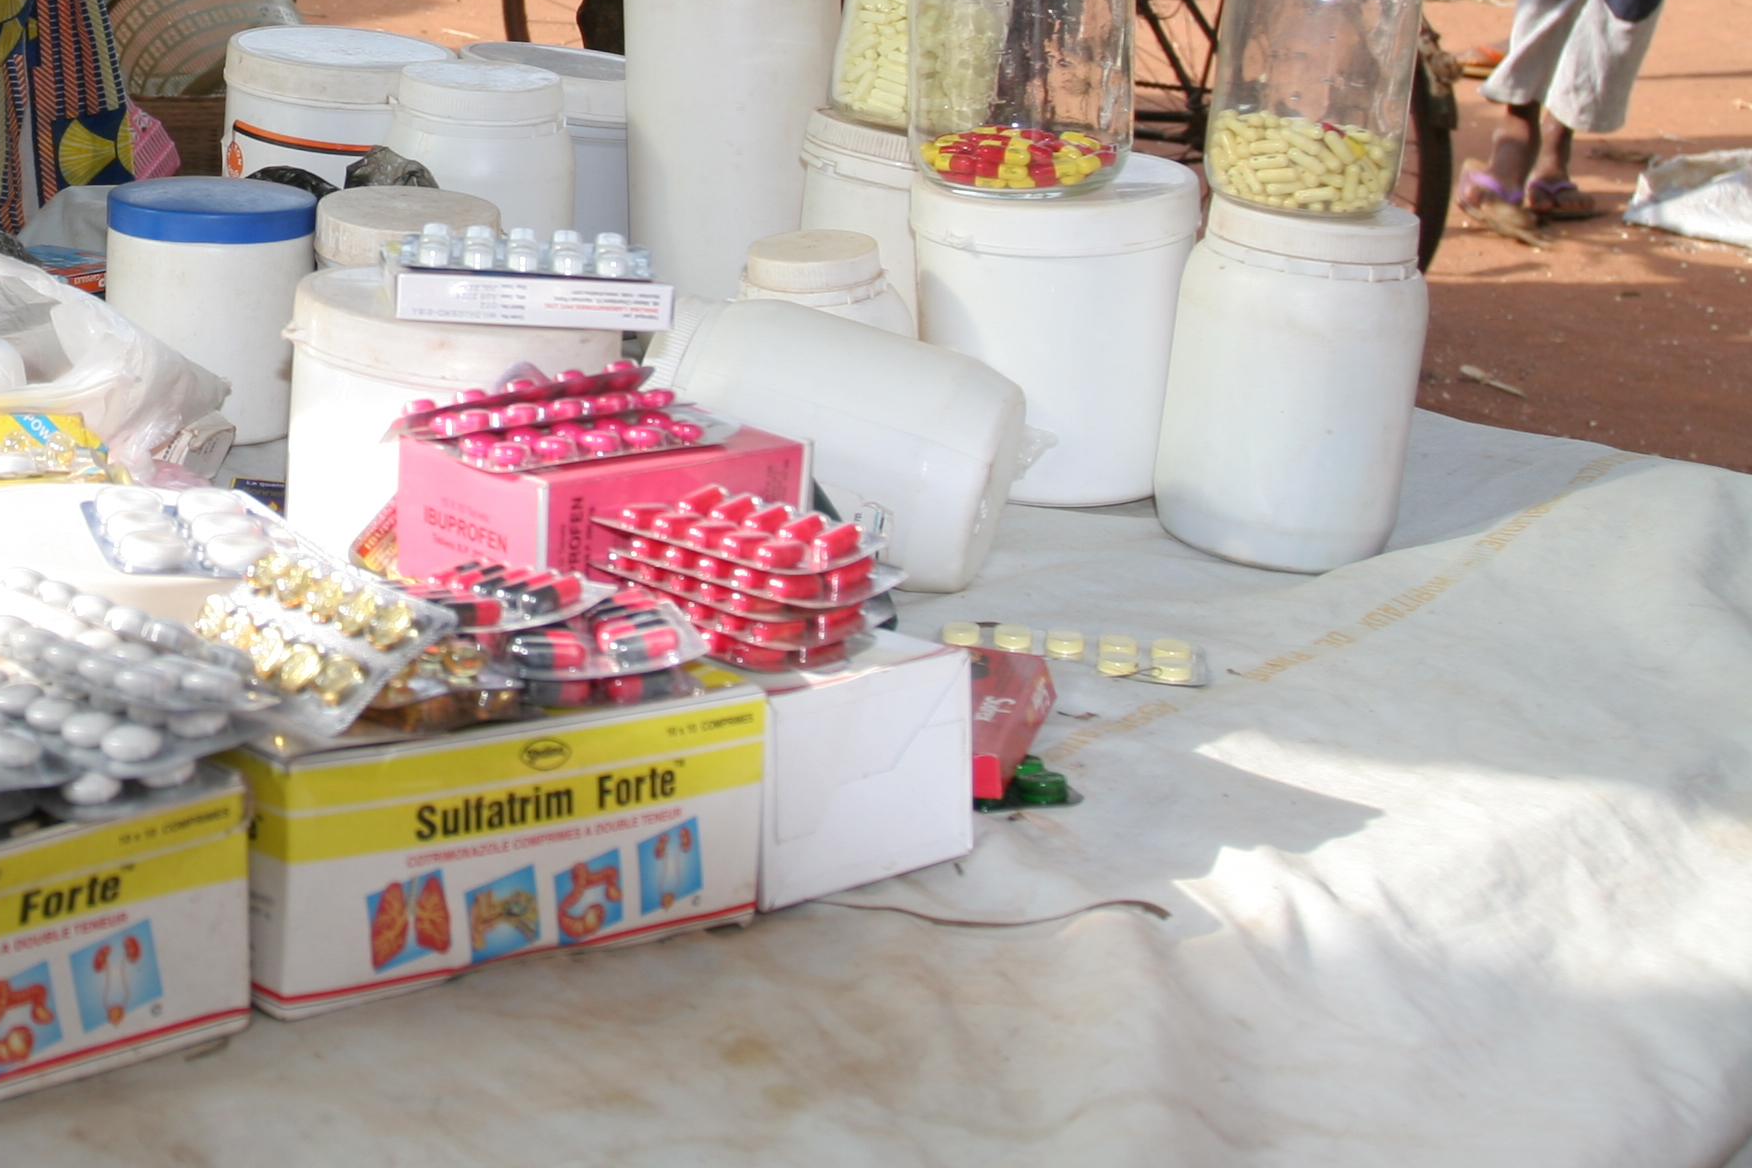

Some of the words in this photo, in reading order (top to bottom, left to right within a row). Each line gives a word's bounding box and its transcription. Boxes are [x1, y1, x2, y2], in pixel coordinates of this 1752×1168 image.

[23, 414, 51, 440] POW
[423, 505, 509, 554] IBUPROFEN
[415, 786, 574, 842] Sulfatrim
[598, 767, 677, 811] Forte
[596, 816, 640, 834] DOUBLE
[19, 874, 121, 925] Forte
[14, 928, 71, 952] DOUBLE
